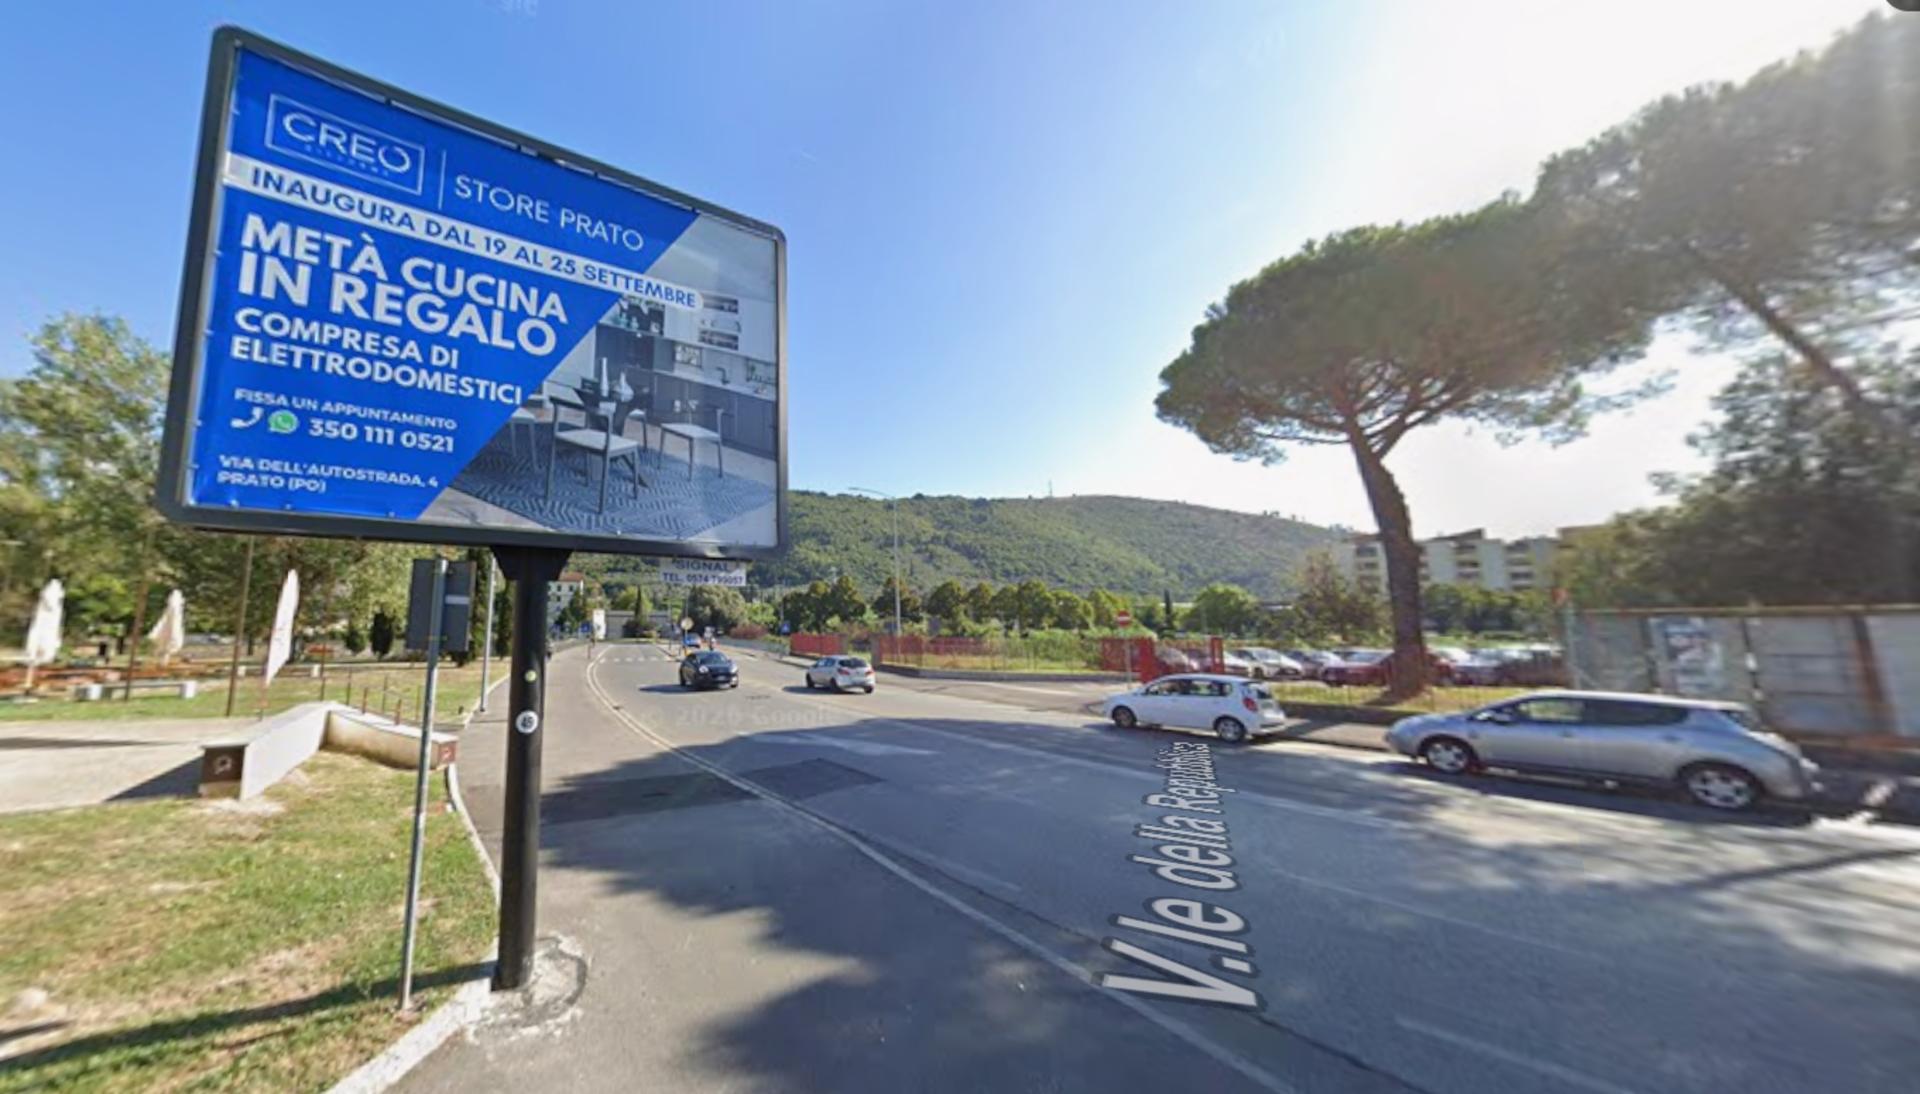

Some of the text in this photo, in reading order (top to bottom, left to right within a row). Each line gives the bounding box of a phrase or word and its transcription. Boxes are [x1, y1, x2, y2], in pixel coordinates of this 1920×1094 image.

[282, 111, 412, 174] CREO
[252, 167, 697, 309] INAUGURA DAL 19 AL 25 SETTEMBRE
[454, 174, 645, 251] STORE PRATO
[241, 212, 569, 325] METÀ CUCINA
[237, 250, 557, 357] IN REGALO
[230, 334, 523, 405] ELETTRODOMESTICI
[234, 307, 459, 369] COMPRESA DI
[233, 387, 458, 431] FISSA UN APPUNTAMENTO
[308, 417, 455, 453] 350 111 0521
[216, 470, 328, 494] PRATO (PO)
[218, 454, 255, 470] VIA
[428, 475, 438, 488] 4
